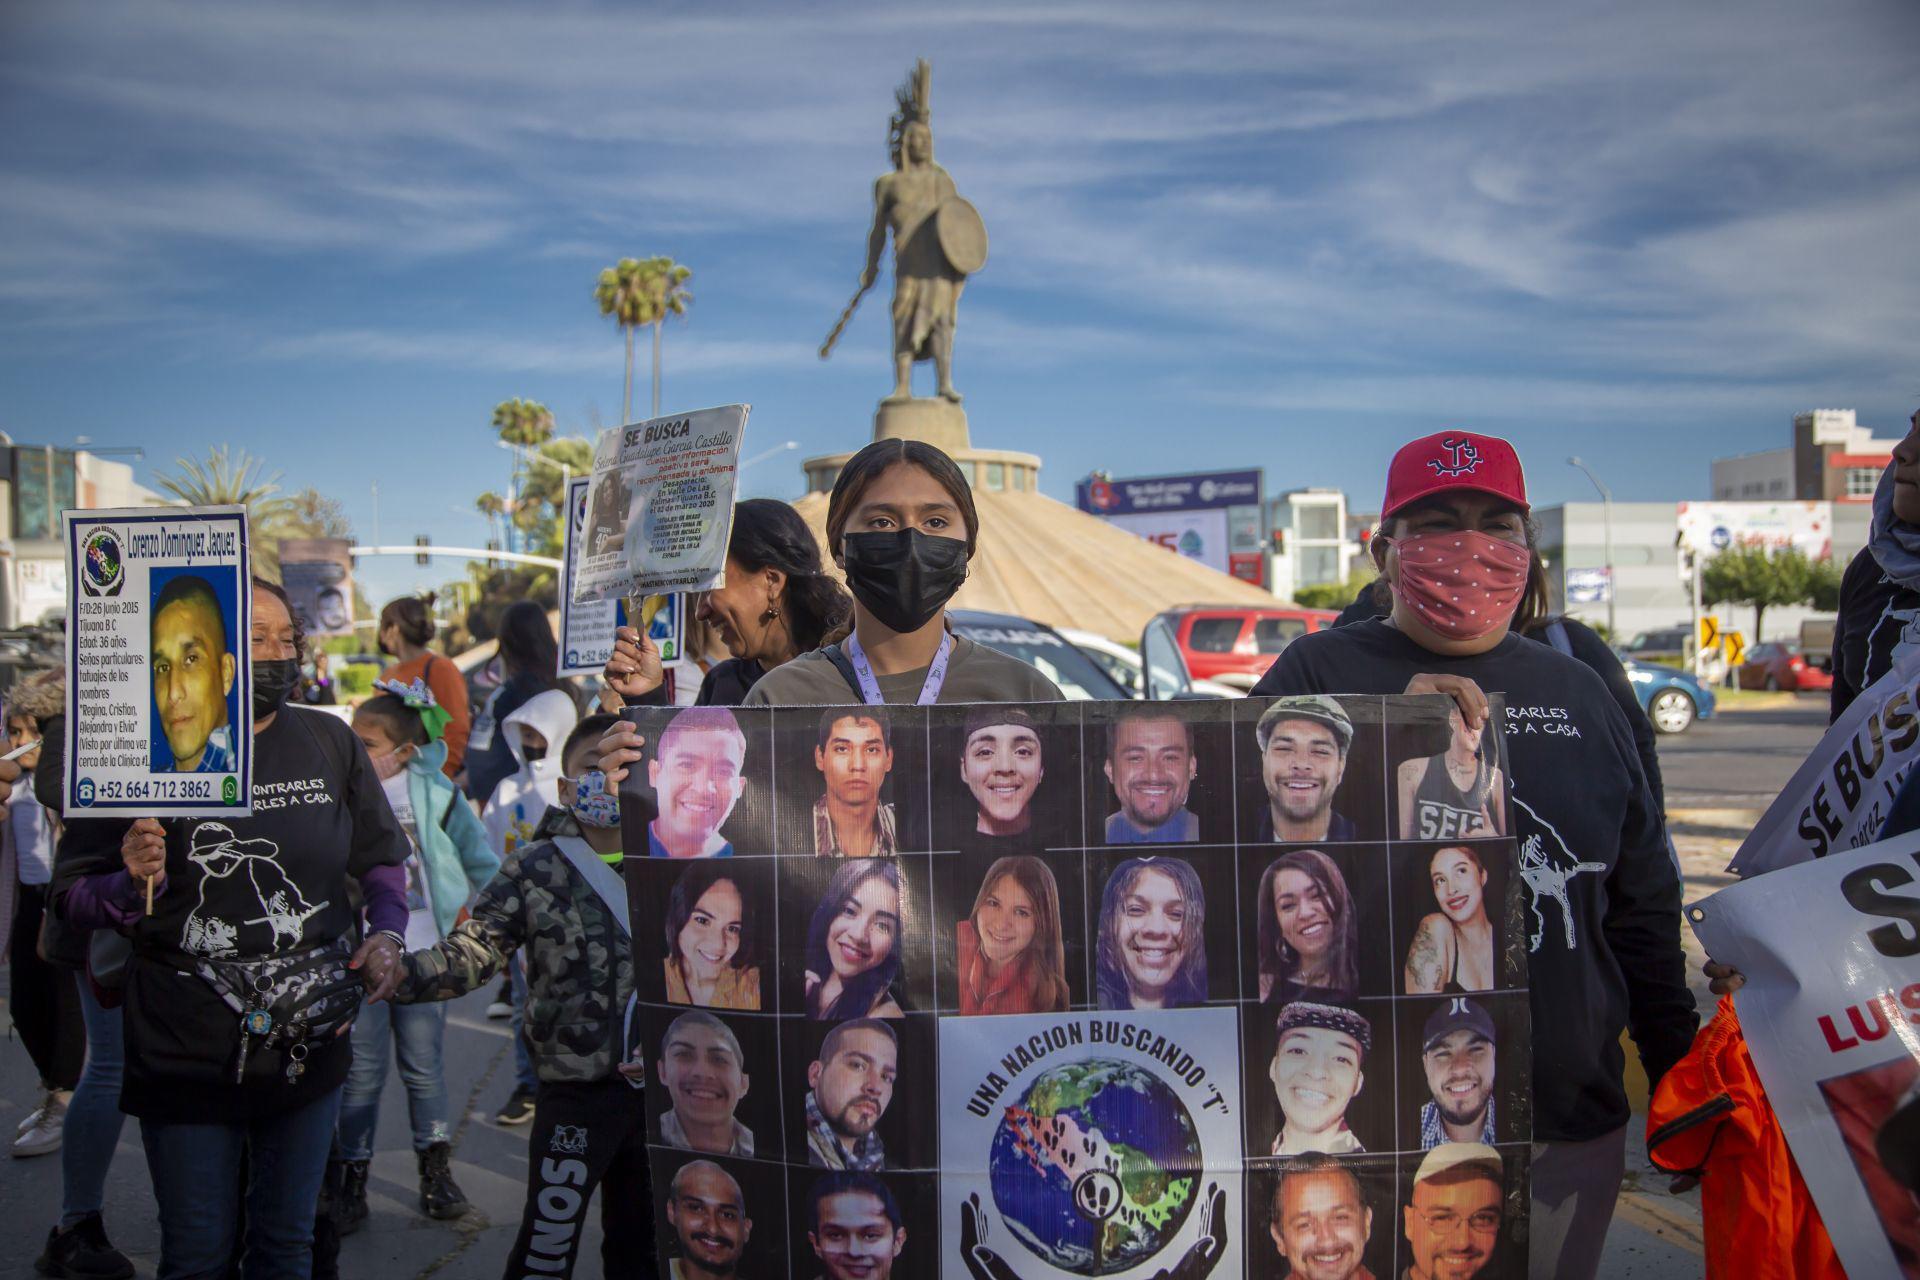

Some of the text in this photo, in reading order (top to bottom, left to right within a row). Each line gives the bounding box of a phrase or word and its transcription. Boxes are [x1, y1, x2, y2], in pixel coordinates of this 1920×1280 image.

[624, 418, 690, 448] SE BUSCA
[695, 430, 733, 449] Castillo
[646, 446, 729, 466] Cualquier información
[657, 489, 666, 497] En
[668, 486, 685, 496] Valle
[687, 485, 697, 493] De
[665, 504, 674, 512] de
[675, 502, 698, 511] marzo
[699, 499, 715, 508] 2020
[127, 524, 235, 566] Lorenzo Domínguez Jaquez
[122, 601, 139, 614] 2015
[80, 618, 117, 634] Tijuana B C
[80, 635, 127, 648] Edad: 36 años
[80, 652, 144, 668] Señas particulares:
[599, 648, 613, 661] 66
[80, 669, 129, 683] tatuajes de los
[80, 686, 110, 700] nombres
[1505, 706, 1568, 719] RARLES
[80, 720, 113, 736] Alejandra
[114, 723, 118, 736] y
[1525, 722, 1538, 734] A
[1543, 723, 1581, 739] CASA
[100, 739, 112, 753] por
[136, 739, 147, 750] vez
[79, 756, 98, 767] cerca
[99, 754, 108, 767] de
[109, 754, 116, 767] la
[1798, 780, 1843, 858] SE
[1833, 682, 1920, 813] BUS
[99, 780, 211, 799] +52 664 712 3862
[252, 792, 333, 811] RLES A CASA
[1840, 851, 1920, 958] S
[966, 1072, 1009, 1118] UNA
[1001, 1021, 1083, 1078] NACION
[1089, 1020, 1206, 1088] BUSCANDO
[521, 1156, 588, 1280] SONI
